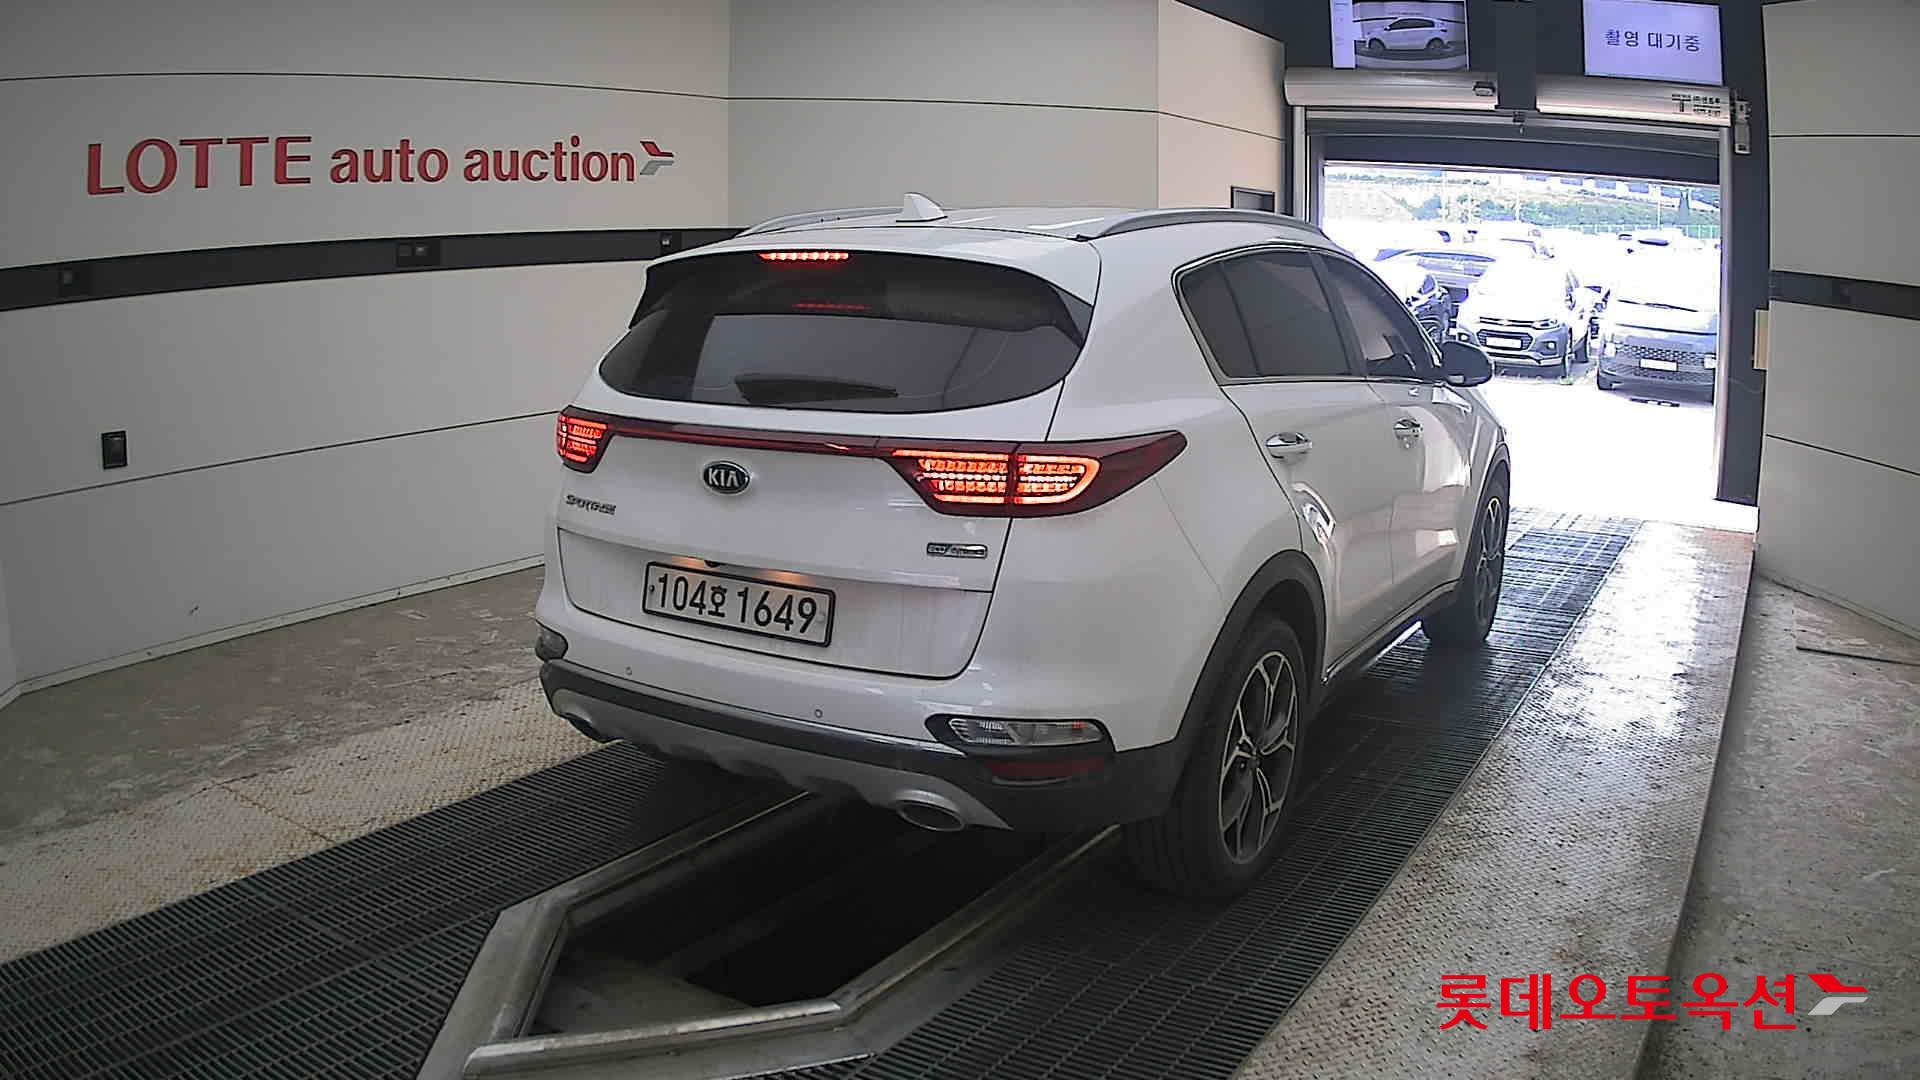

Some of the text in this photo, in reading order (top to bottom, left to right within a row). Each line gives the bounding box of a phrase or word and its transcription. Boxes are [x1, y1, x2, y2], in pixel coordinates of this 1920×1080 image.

[1647, 32, 1700, 52] 대기중
[87, 136, 635, 195] LOTTE auto auction
[708, 467, 739, 487] KIA
[658, 572, 817, 634] 104호 1649
